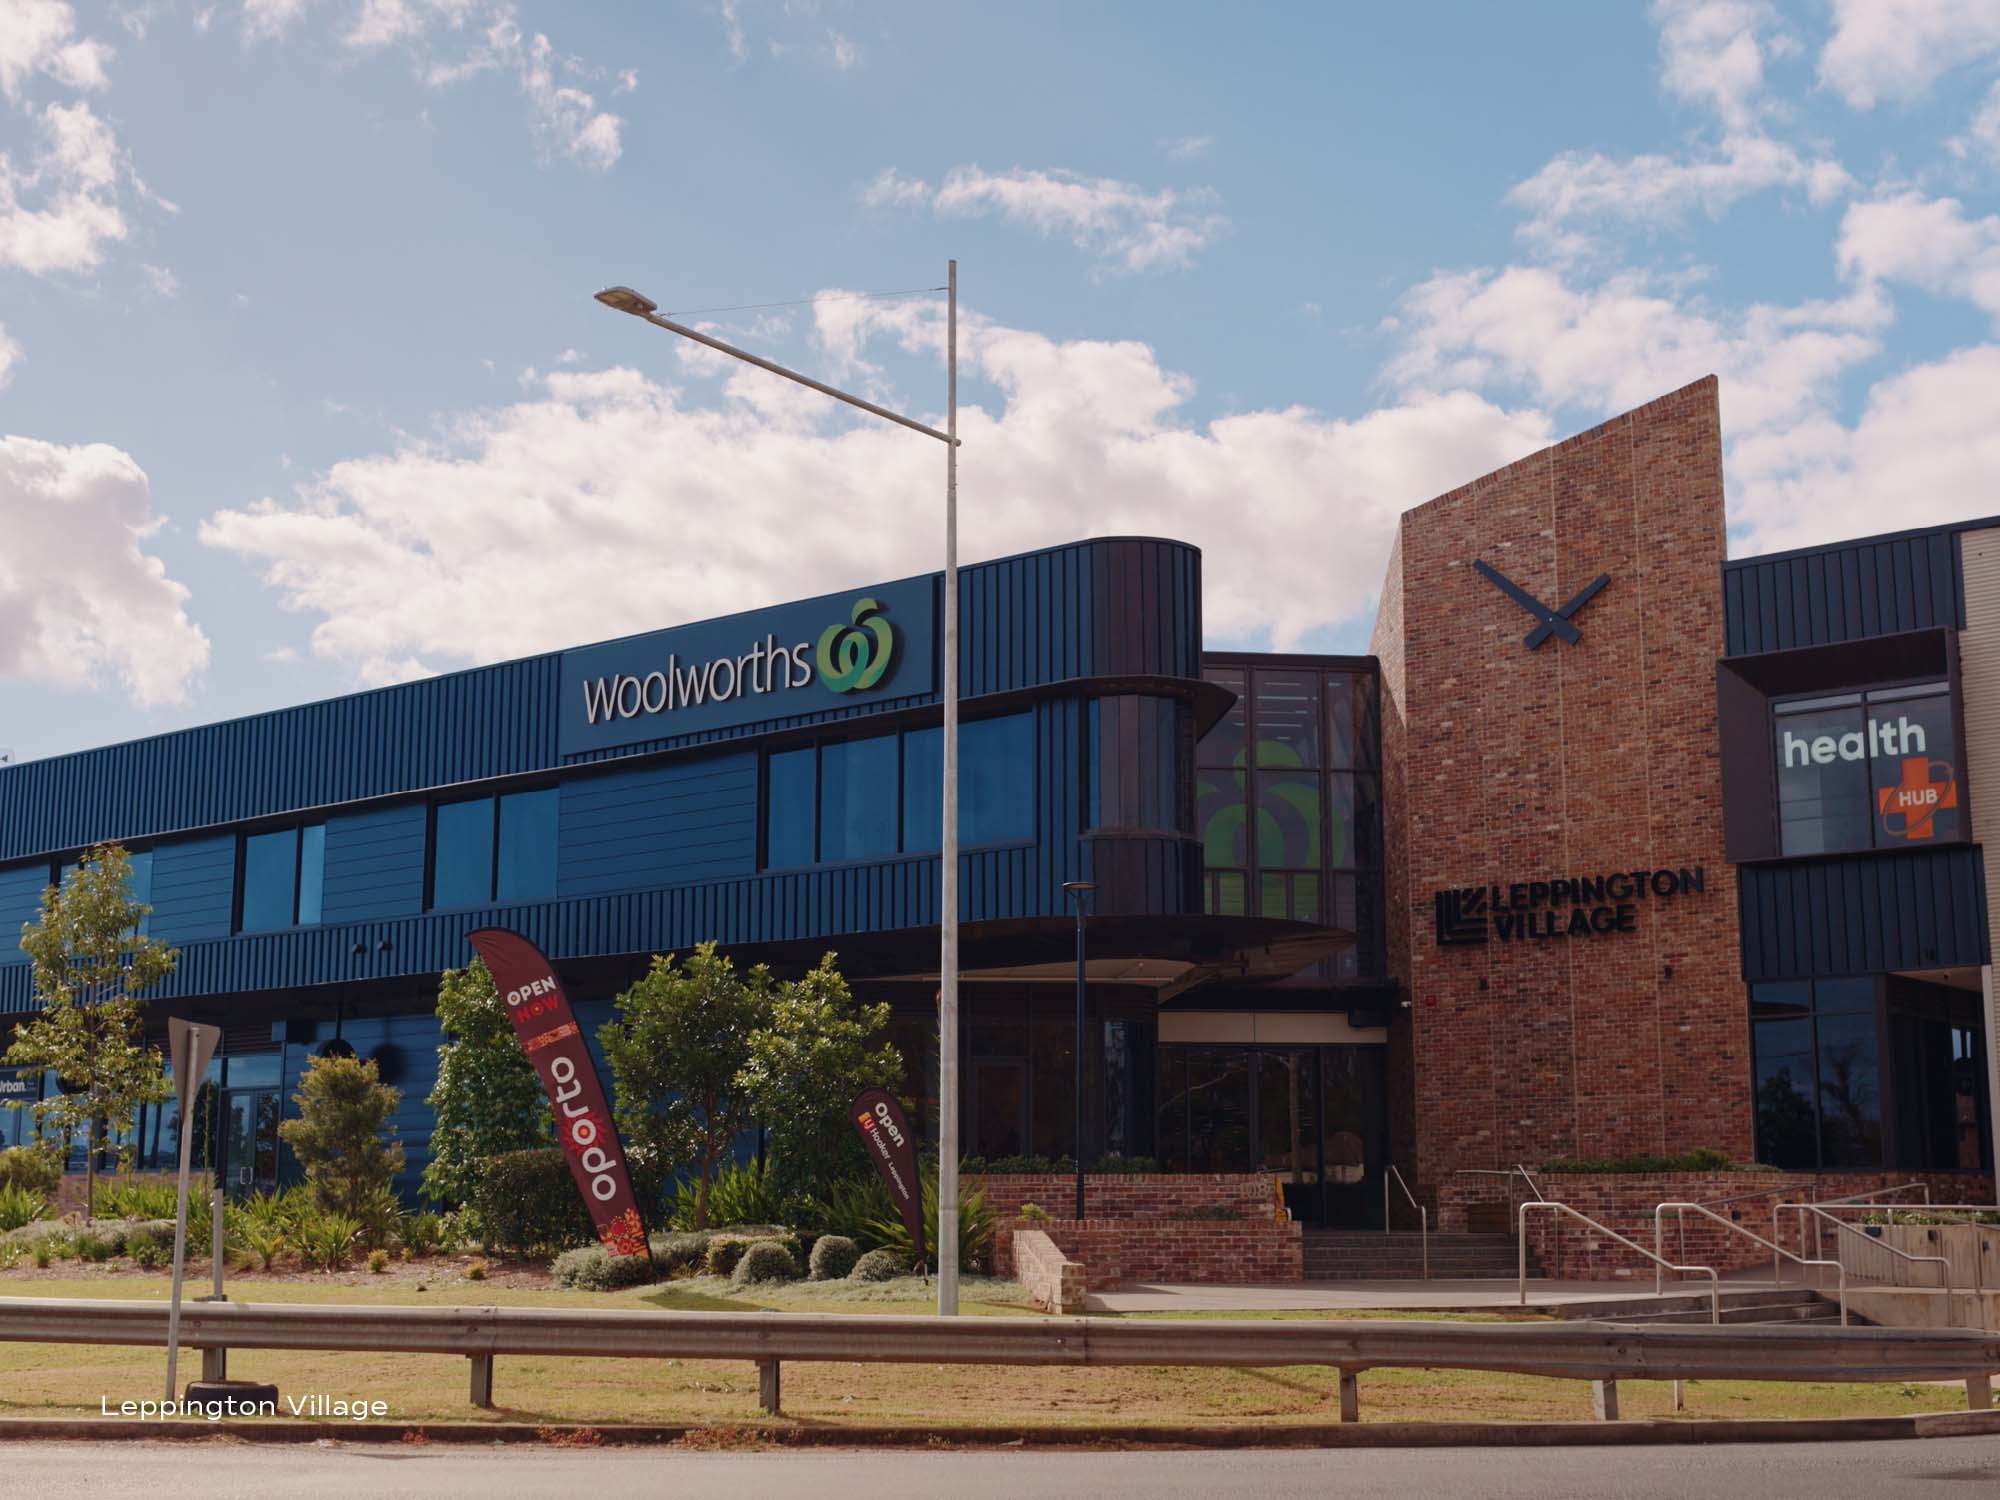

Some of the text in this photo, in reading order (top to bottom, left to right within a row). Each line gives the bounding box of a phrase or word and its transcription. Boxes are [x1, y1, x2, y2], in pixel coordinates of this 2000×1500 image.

[1783, 716, 1926, 768] health
[1899, 788, 1938, 807] HUB
[1491, 866, 1705, 912] LEPPINGTON
[1493, 903, 1637, 943] VILLAGE
[507, 975, 557, 1006] OPEN
[515, 993, 559, 1023] NOW
[551, 1056, 617, 1201] oporto
[875, 1102, 905, 1148] Open
[869, 1127, 892, 1160] Hooker
[887, 1161, 911, 1201] Leppington
